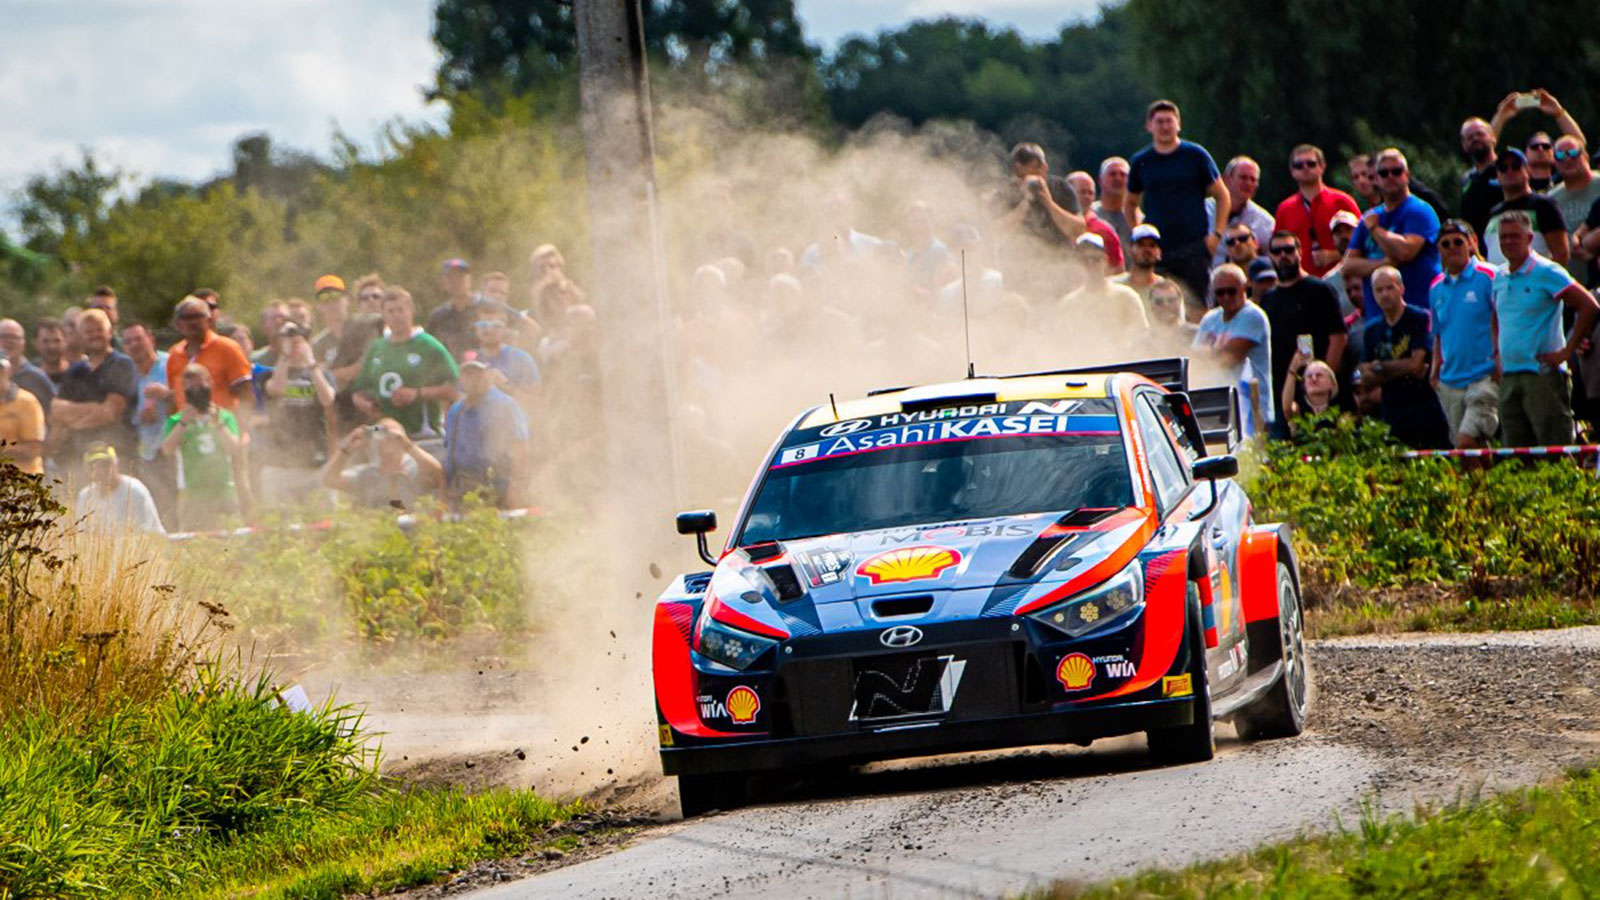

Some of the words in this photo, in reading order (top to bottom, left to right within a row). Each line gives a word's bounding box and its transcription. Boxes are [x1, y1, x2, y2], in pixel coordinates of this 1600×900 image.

[880, 403, 1007, 427] HYUNDAI
[795, 448, 806, 460] 8
[880, 523, 1035, 546] MOBIS
